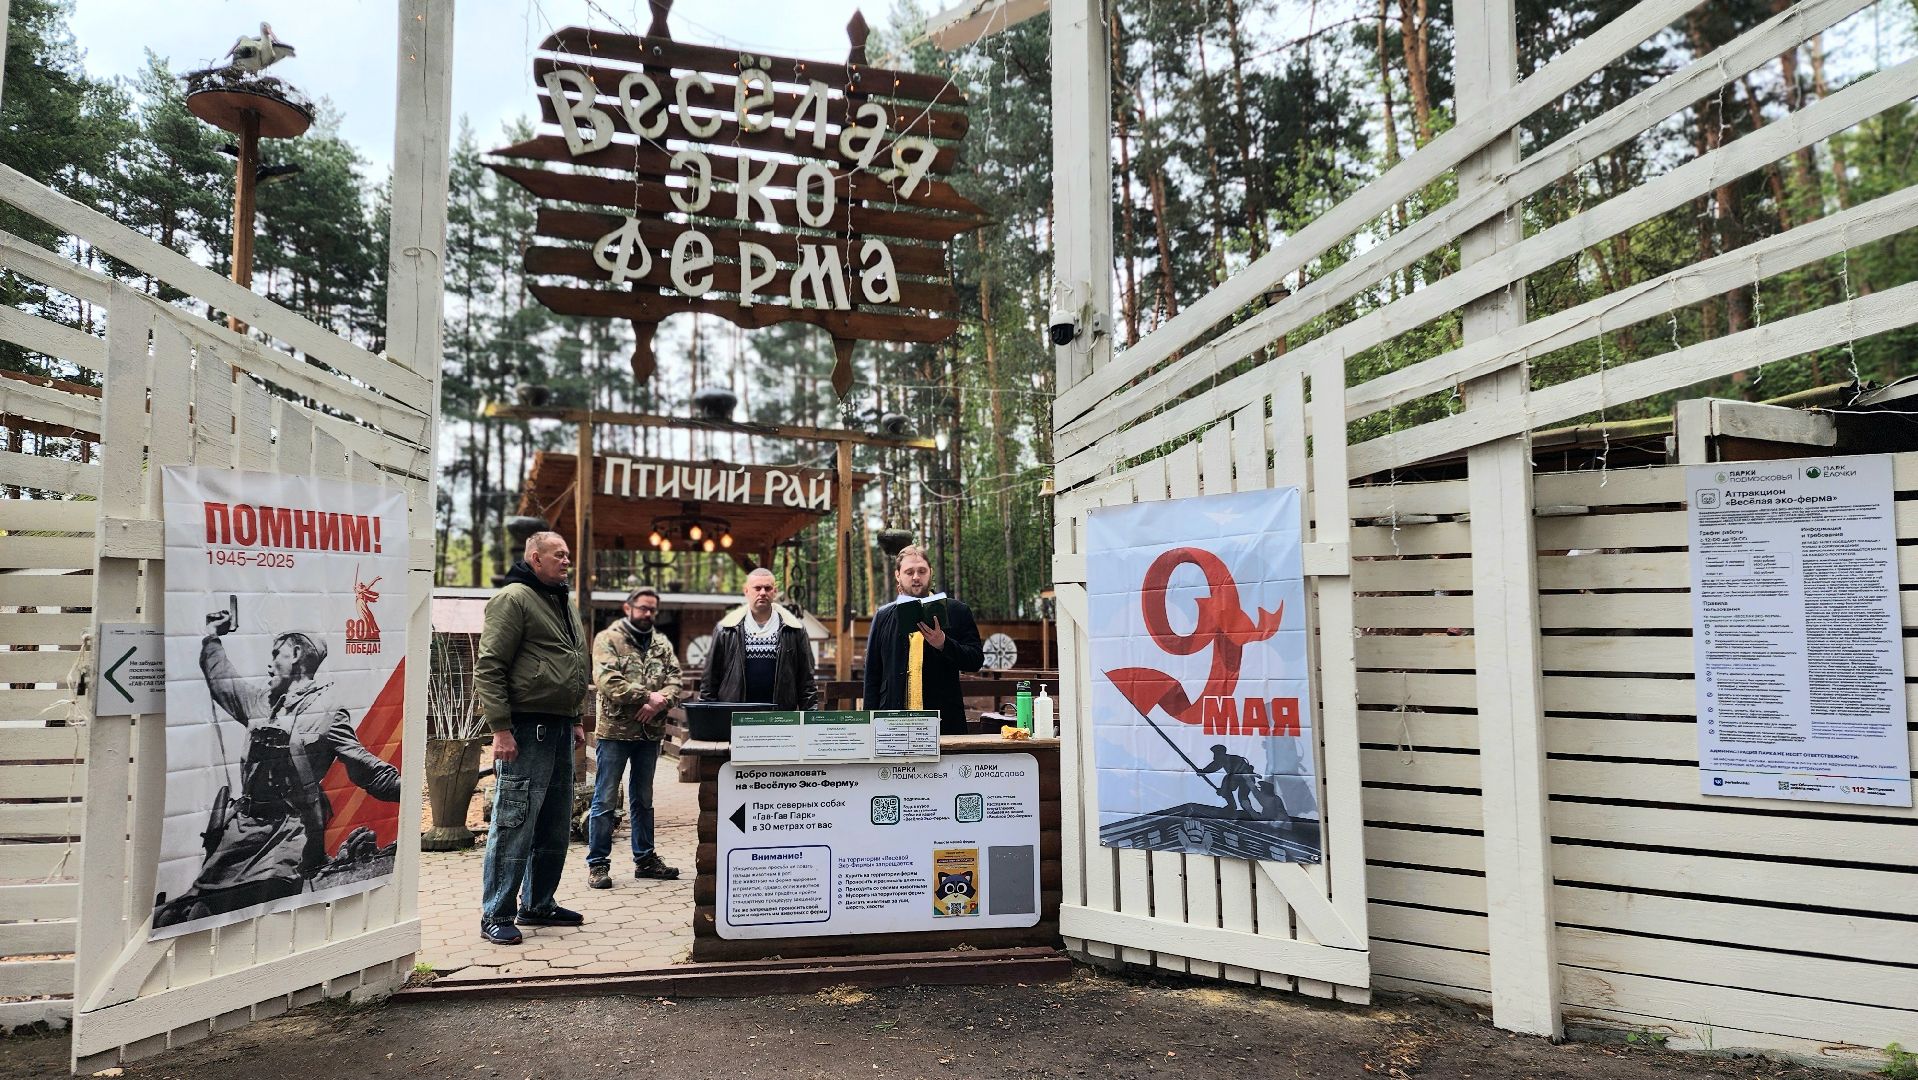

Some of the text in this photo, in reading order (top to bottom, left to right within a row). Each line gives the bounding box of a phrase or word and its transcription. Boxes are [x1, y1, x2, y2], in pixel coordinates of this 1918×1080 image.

[542, 53, 939, 200] Весёлая
[1729, 469, 1756, 477] ПАРКИ
[1730, 474, 1793, 483] ПОДМОСКОВЬЯ
[1725, 489, 1786, 498] Аттракцион
[1725, 494, 1838, 506] «Весёлая эко-ферма»
[204, 501, 382, 553] ПОМНИМ!
[345, 619, 365, 639] 80
[1141, 547, 1248, 724] 9
[345, 643, 381, 655] ПОБЕДА!
[1202, 695, 1301, 737] МАЯ
[735, 769, 826, 780] Добро пожаловать
[749, 780, 797, 790] «Весёлую
[799, 780, 859, 790] Эко-Ферму»
[1852, 786, 1866, 794] 112
[752, 798, 846, 811] Парк северных собак
[752, 812, 816, 821] «Гав-Гав Парк»
[773, 823, 804, 832] метрах
[751, 852, 803, 861] Внимание!
